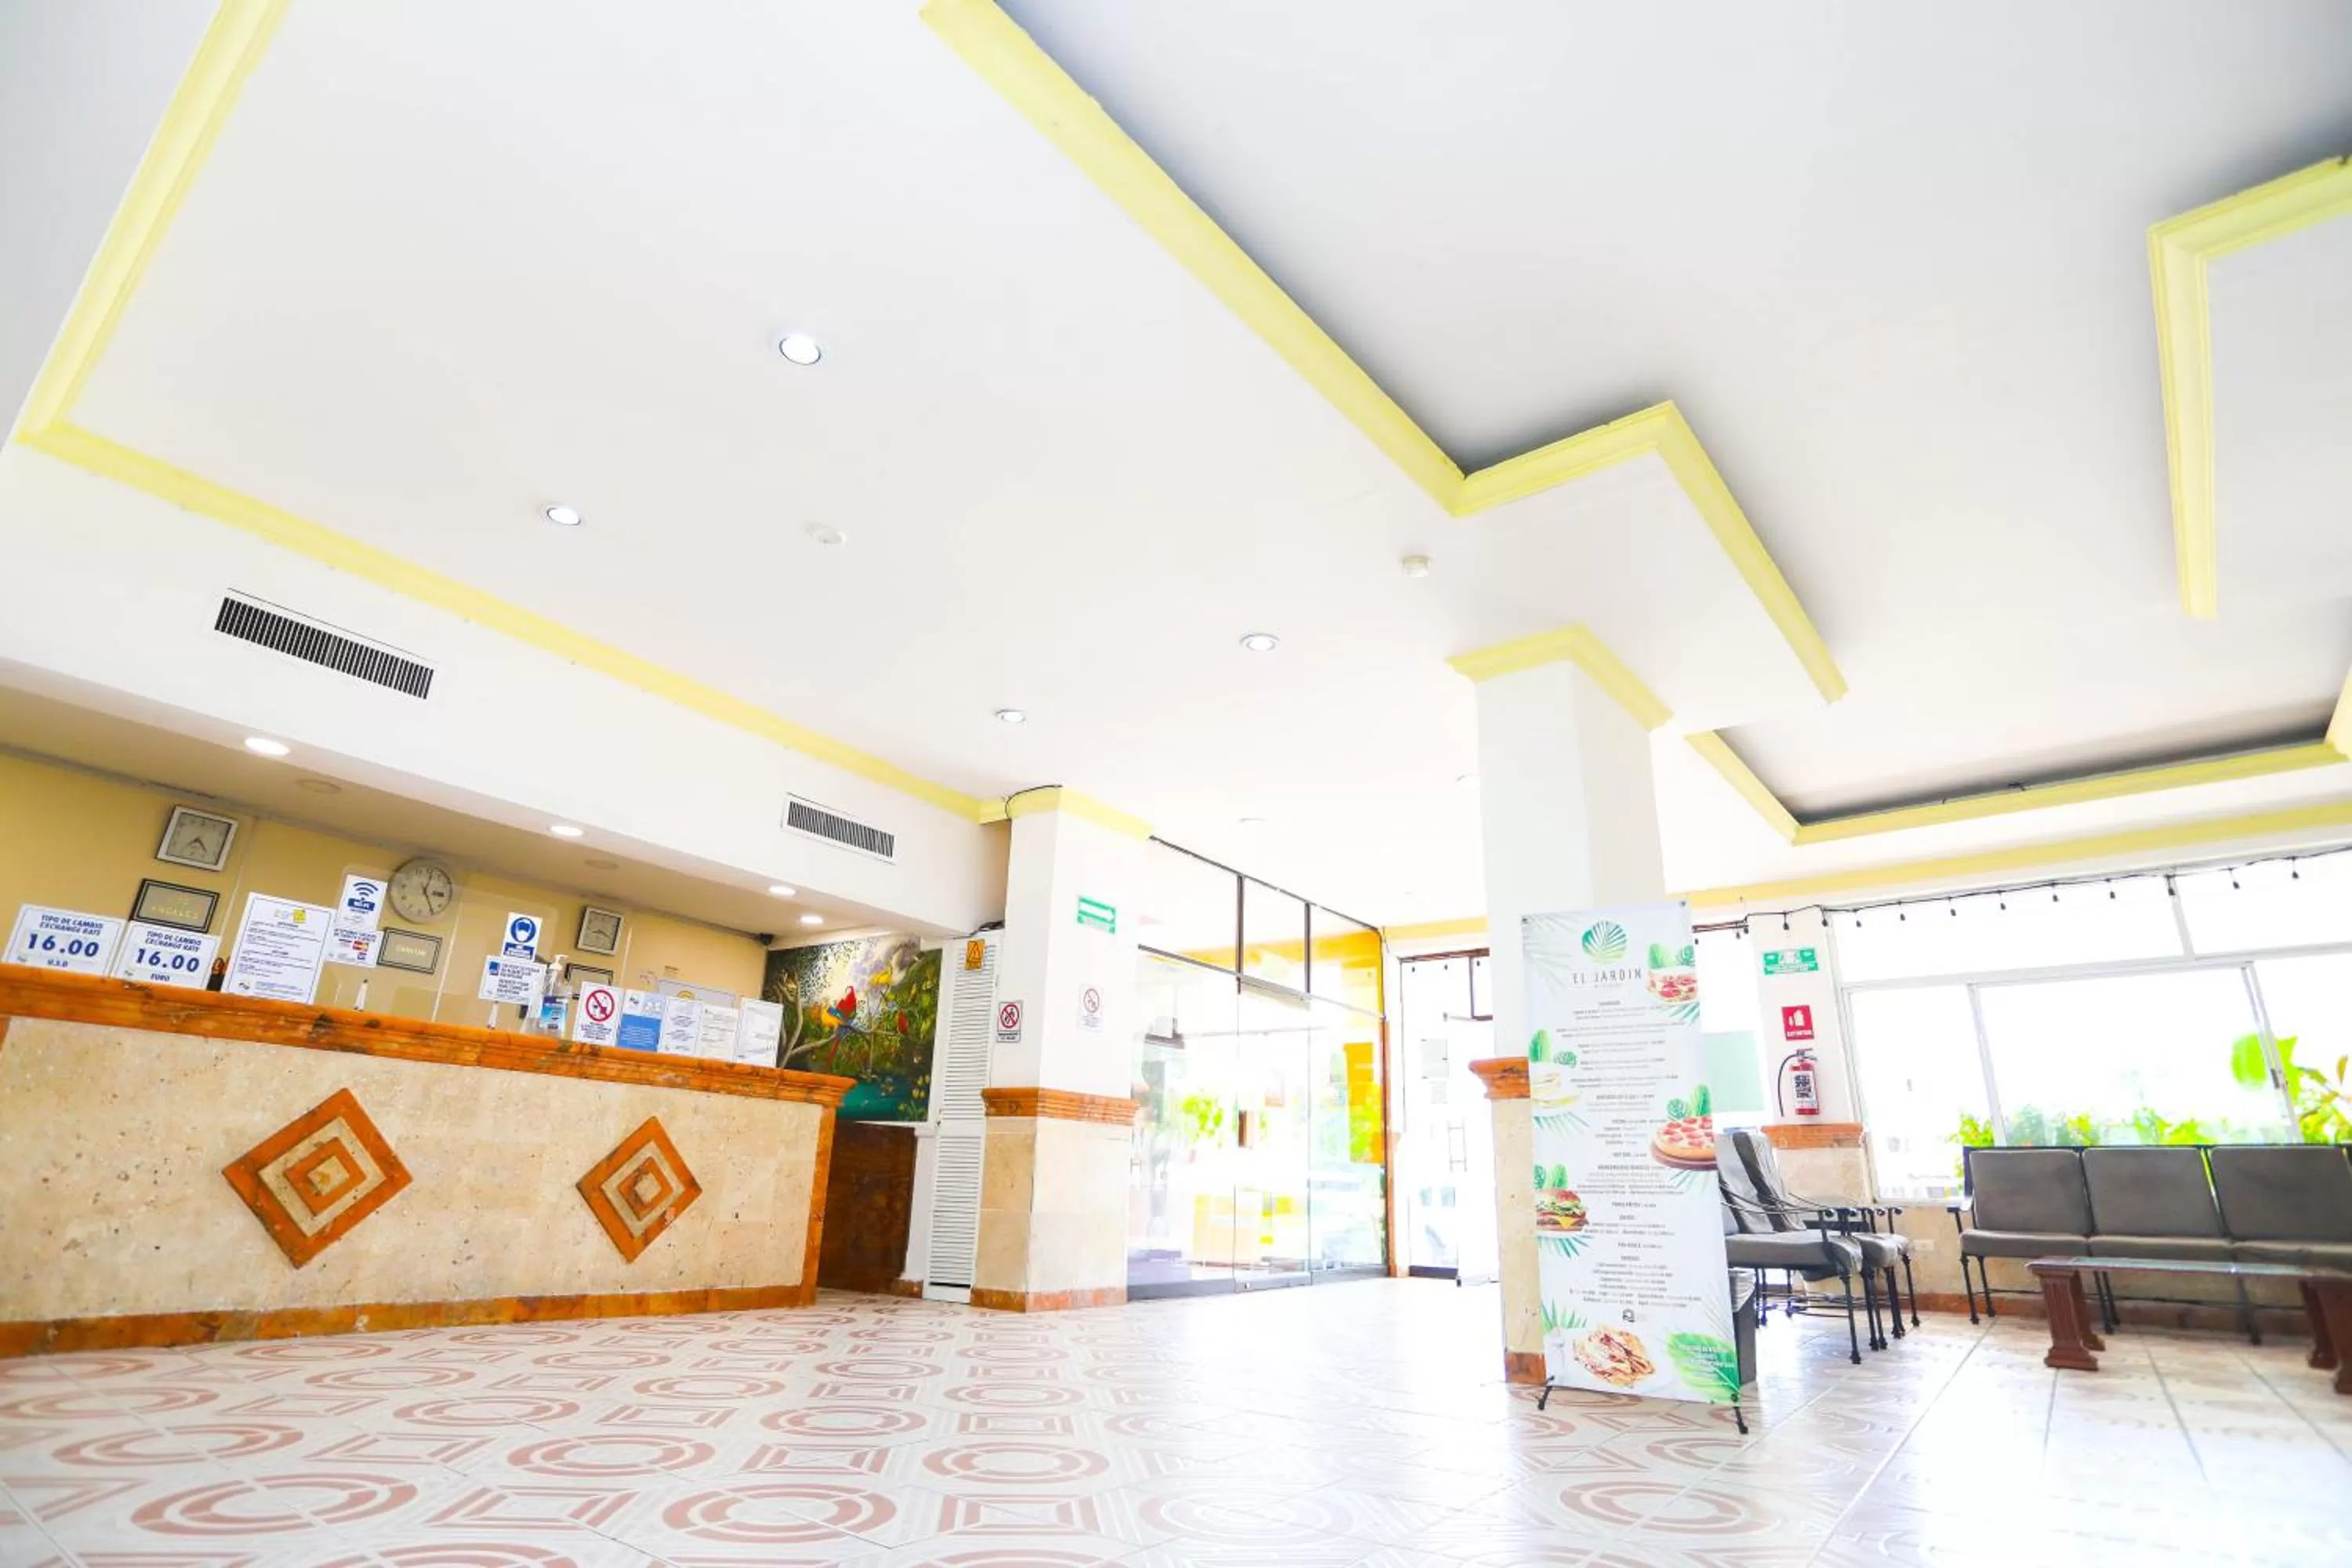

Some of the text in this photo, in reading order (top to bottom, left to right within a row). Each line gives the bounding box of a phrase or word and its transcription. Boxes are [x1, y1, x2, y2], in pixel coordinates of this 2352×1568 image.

[39, 921, 101, 936] EXCHANGE RATE
[72, 920, 103, 929] CAMBIO
[27, 933, 100, 957] 16.00
[145, 938, 200, 953] EXCHANGE RATE
[147, 931, 163, 939] TIPO
[174, 935, 201, 945] CAMBIO
[136, 948, 200, 972] 16.00
[1571, 973, 1585, 985] EL
